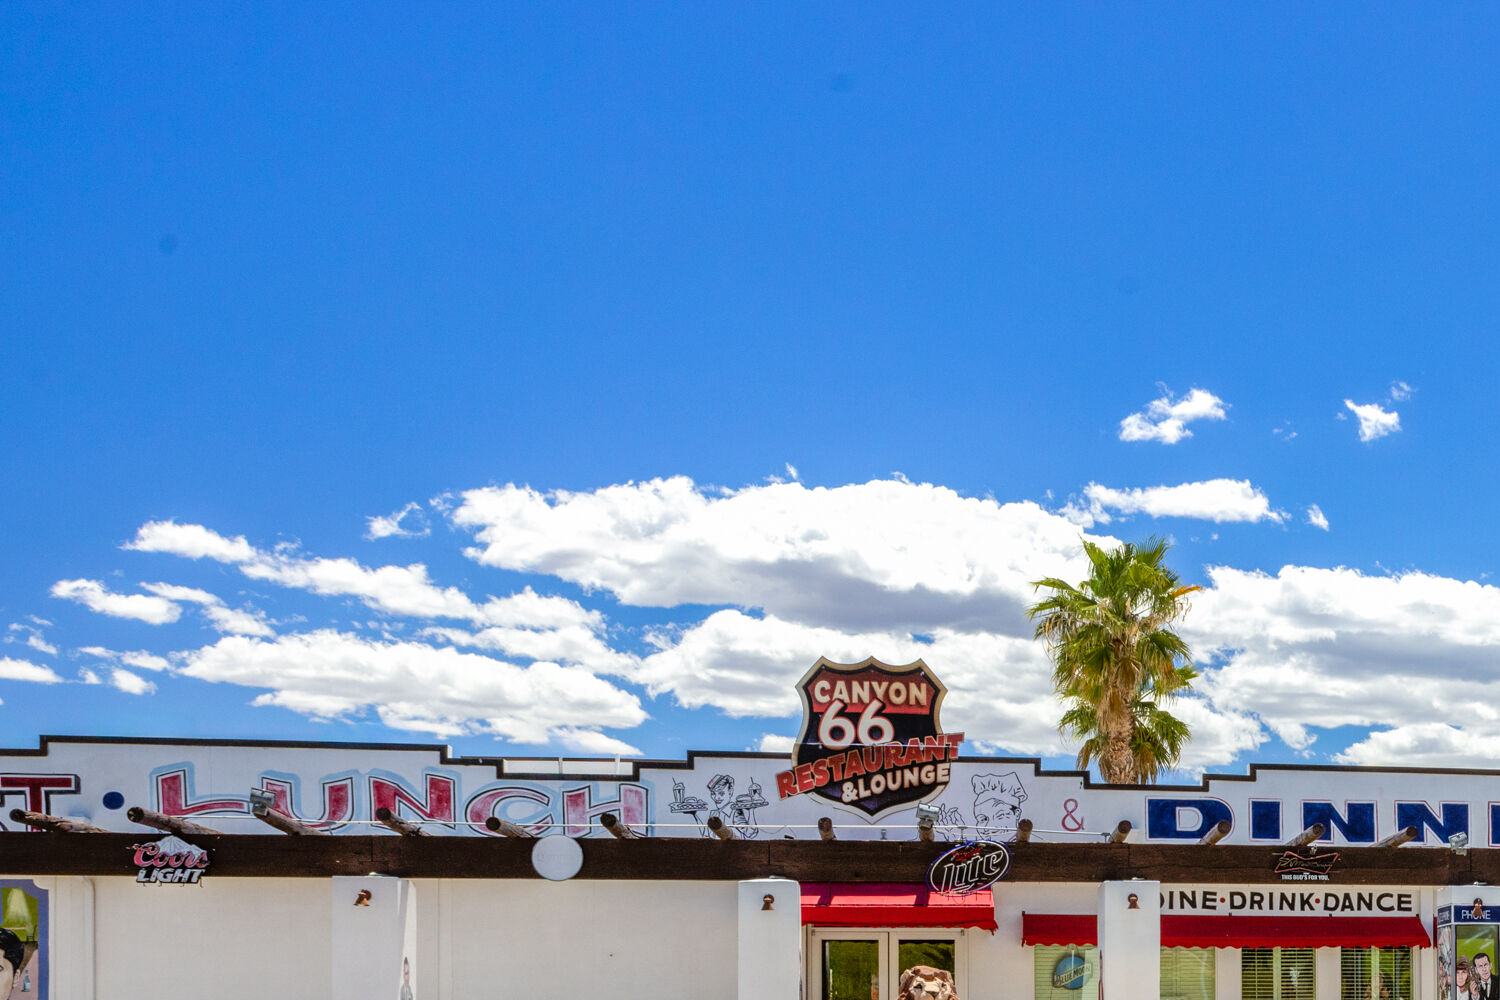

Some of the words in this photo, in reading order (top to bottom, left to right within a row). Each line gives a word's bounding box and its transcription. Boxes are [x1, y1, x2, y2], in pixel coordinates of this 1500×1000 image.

[814, 680, 927, 706] CANYON
[818, 698, 895, 750] 66
[776, 732, 965, 801] RESTAURANT
[0, 772, 81, 833] T
[152, 766, 652, 836] LUNCH
[1061, 798, 1085, 832] &
[133, 841, 210, 867] Coors
[136, 868, 207, 884] LIGHT
[1160, 891, 1217, 910] INE
[1461, 909, 1491, 920] PHNE
